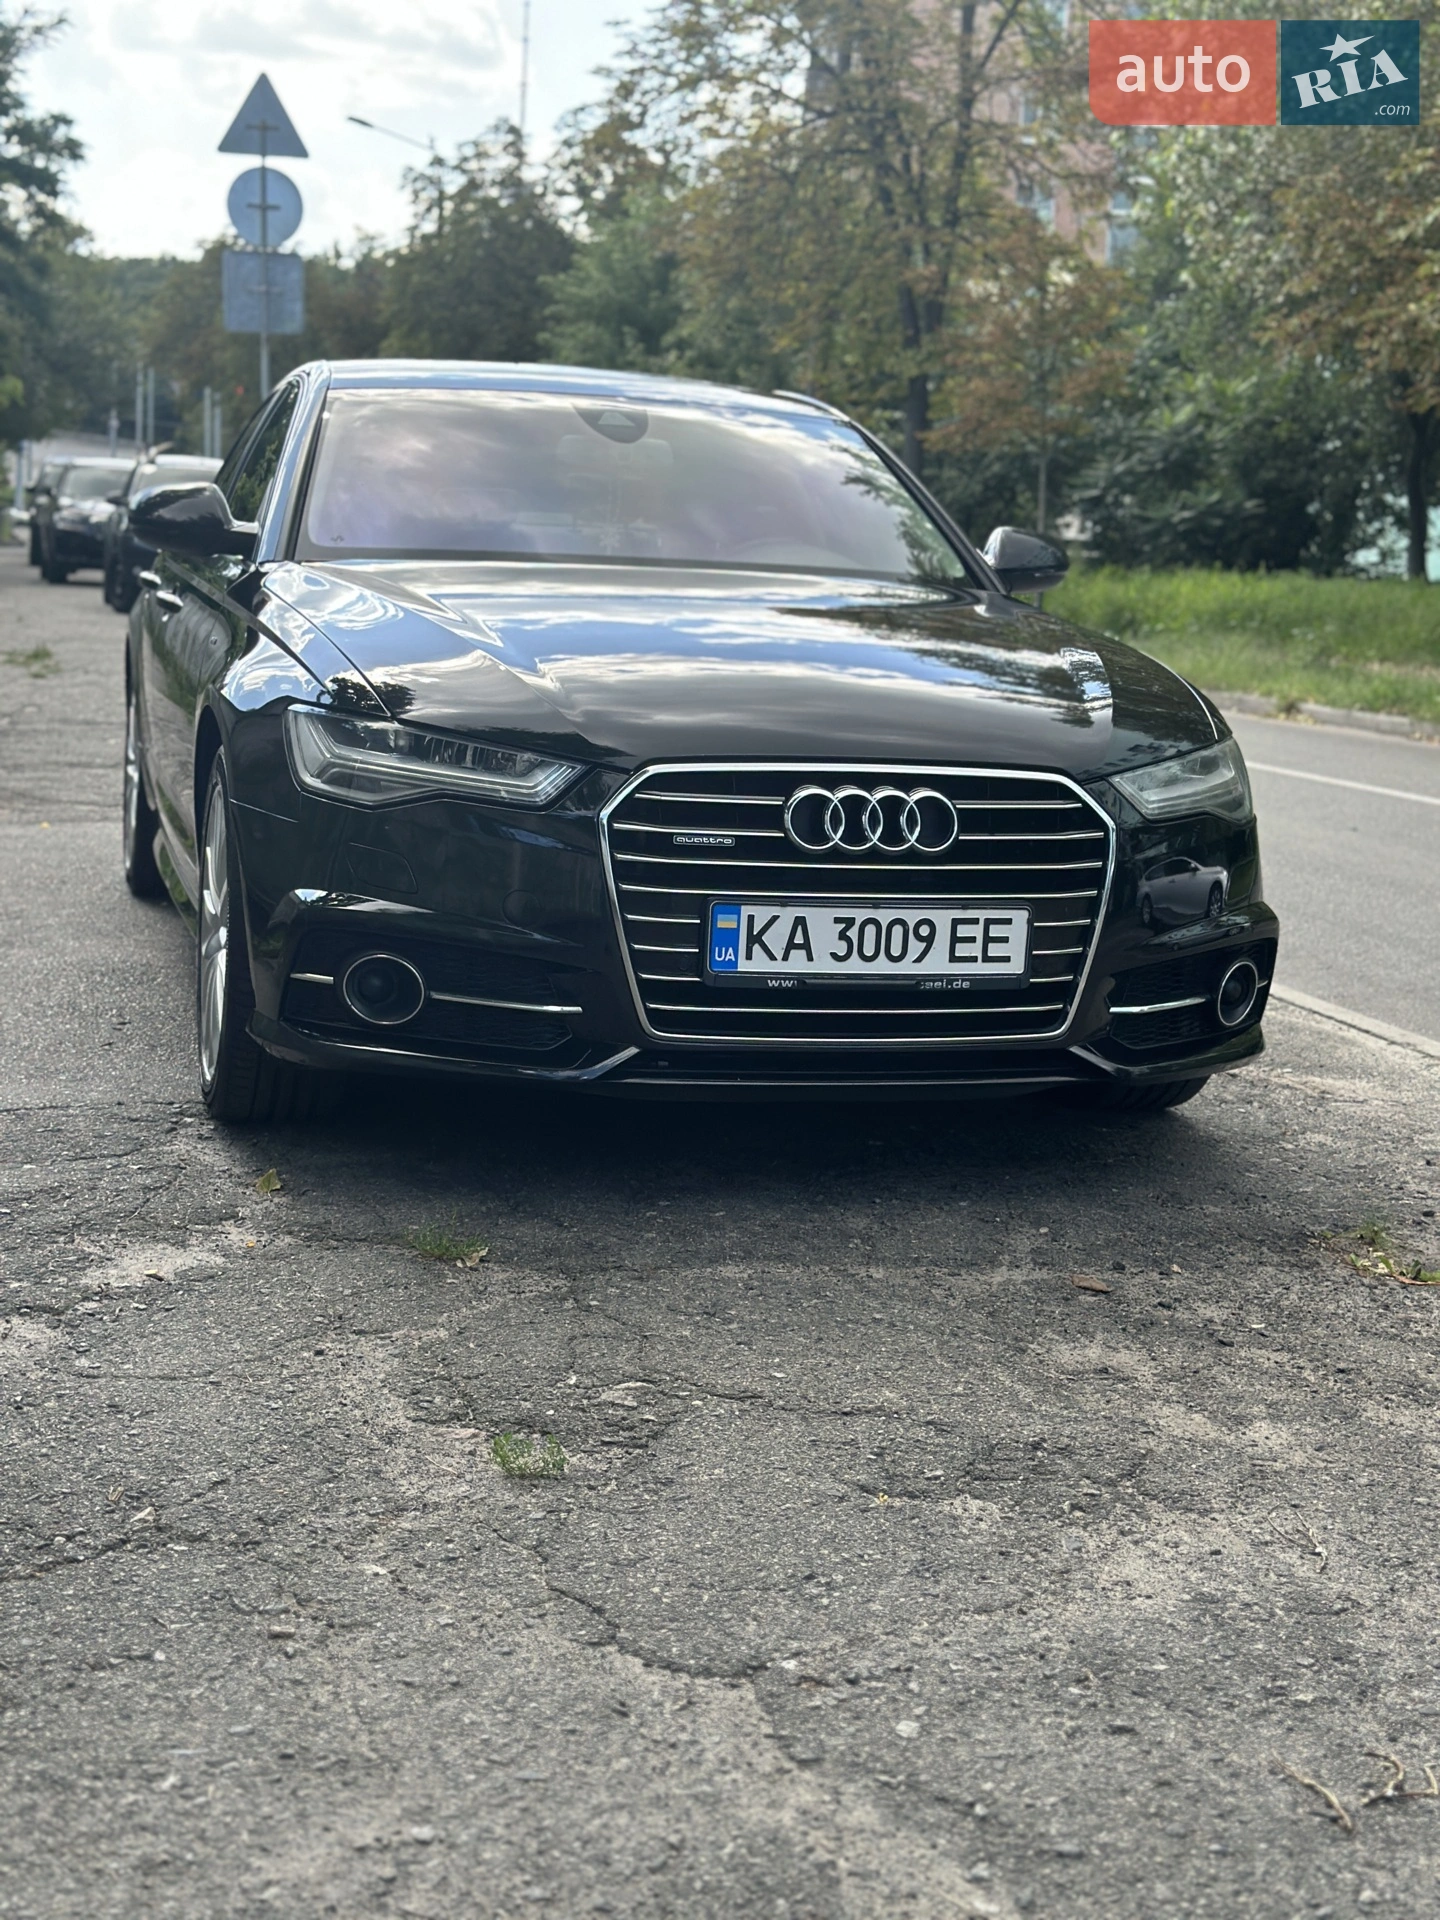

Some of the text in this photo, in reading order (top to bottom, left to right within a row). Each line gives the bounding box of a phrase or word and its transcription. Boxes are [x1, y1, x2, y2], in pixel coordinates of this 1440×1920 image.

[676, 836, 732, 844] quattro
[745, 914, 1013, 963] KA 3009 EE
[715, 946, 736, 961] UA
